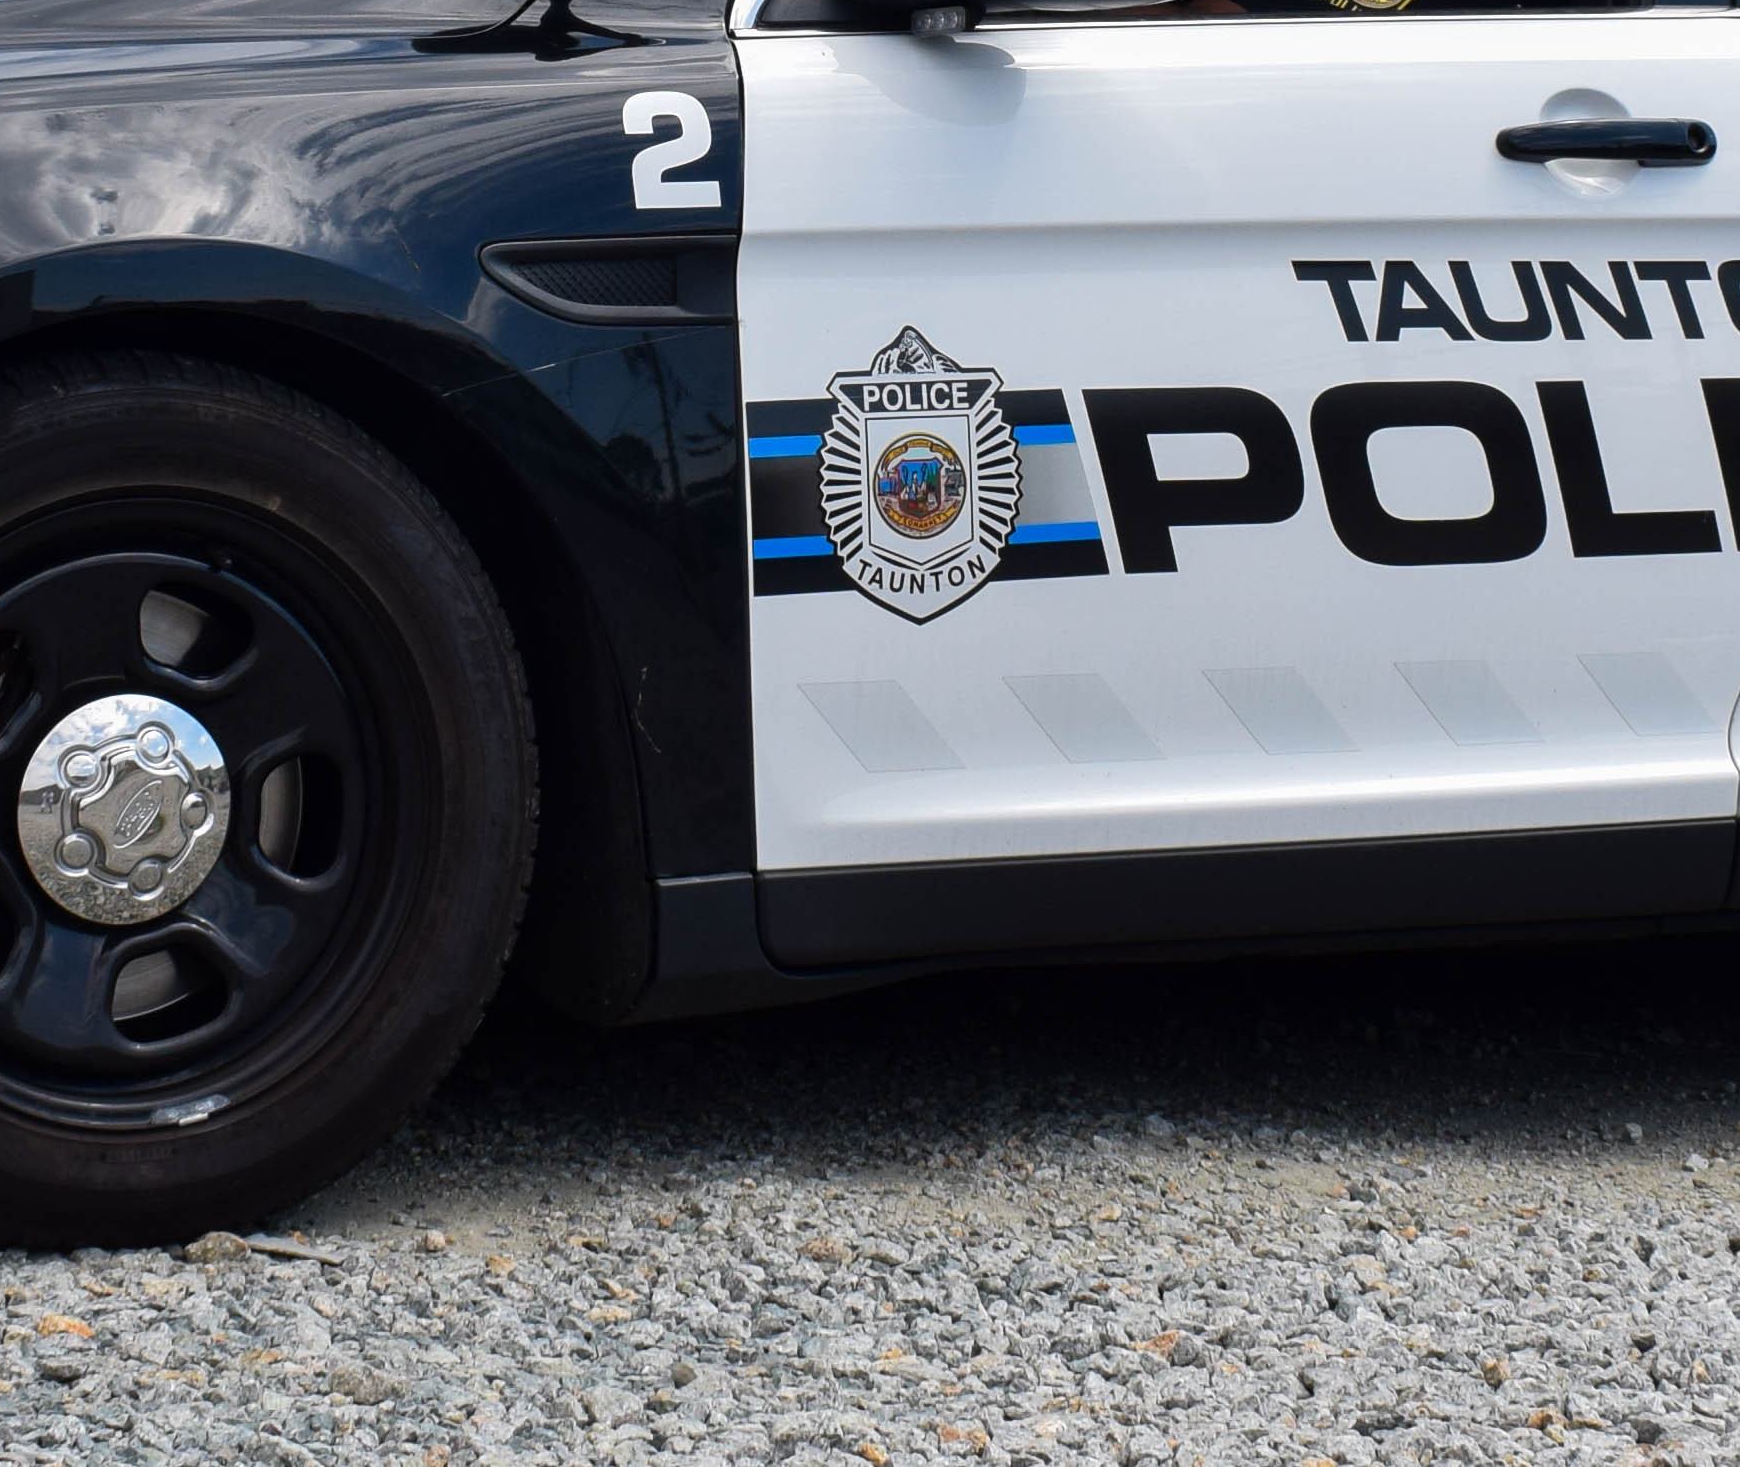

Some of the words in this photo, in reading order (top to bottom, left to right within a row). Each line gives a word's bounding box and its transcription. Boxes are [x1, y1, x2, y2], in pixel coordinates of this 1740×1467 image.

[622, 90, 722, 210] 2
[863, 382, 970, 412] POLICE
[857, 554, 987, 595] TAUNTON
